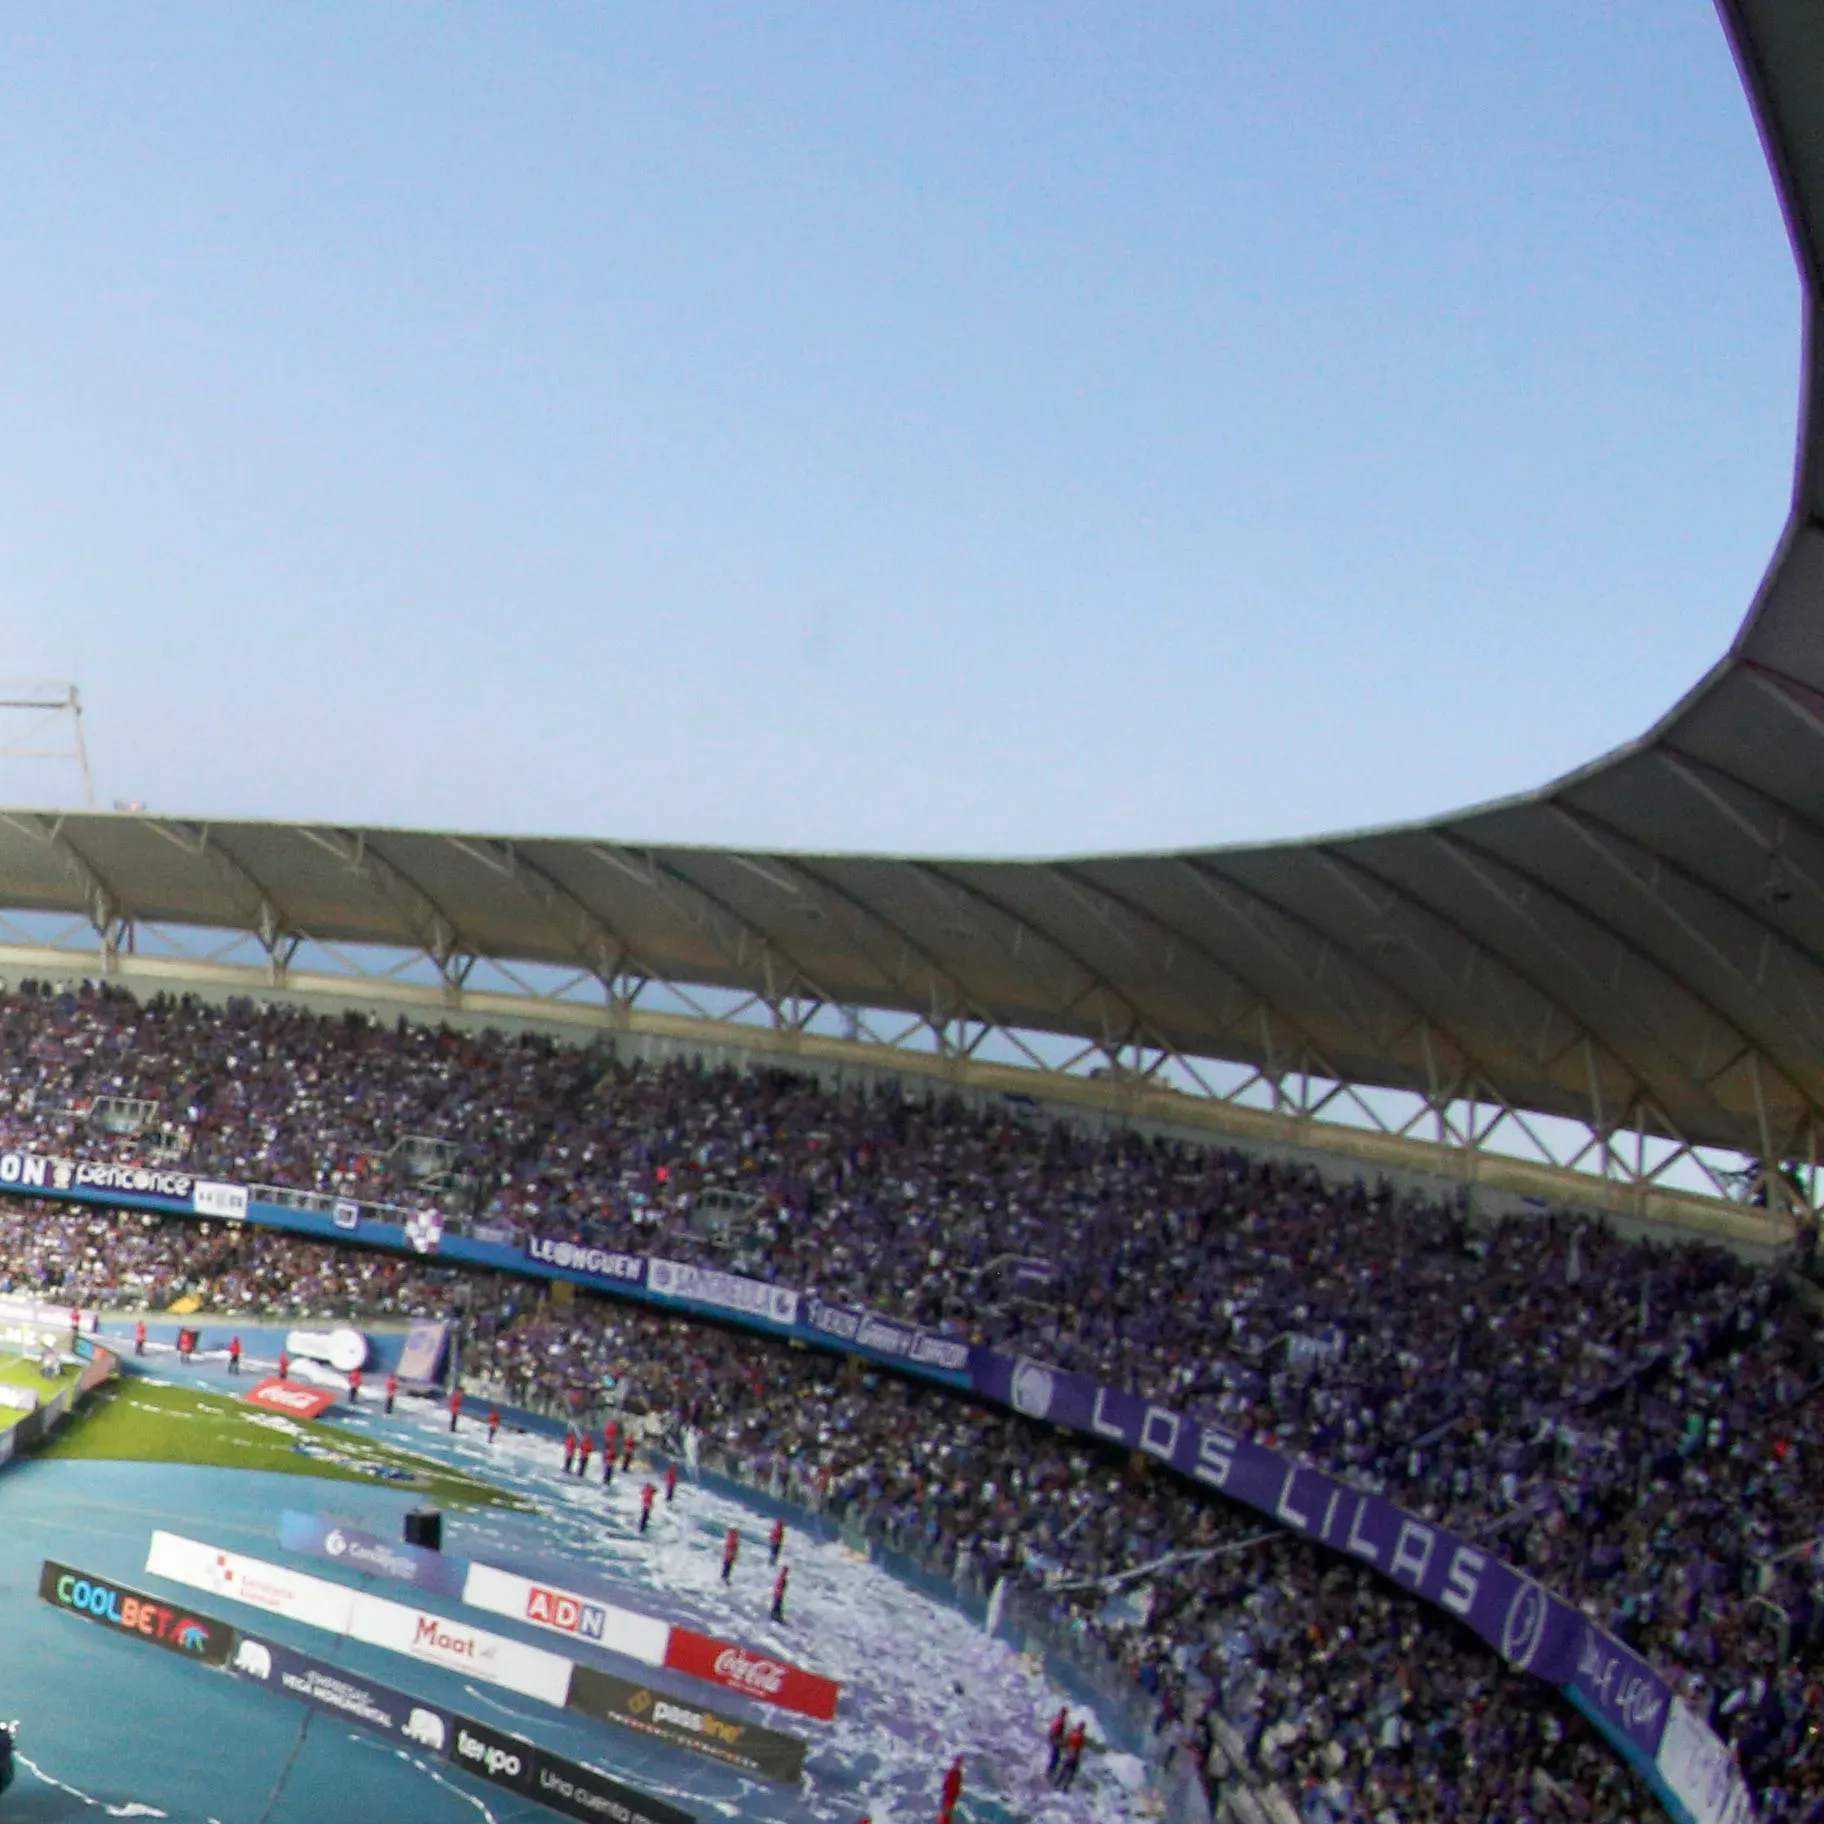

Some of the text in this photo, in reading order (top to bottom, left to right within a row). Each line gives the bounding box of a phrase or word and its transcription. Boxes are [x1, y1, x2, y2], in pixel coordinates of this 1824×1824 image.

[1091, 1387, 1487, 1614] LOS LILAS
[56, 1574, 175, 1639] COOLBET
[528, 1587, 603, 1639] ADN
[414, 1615, 475, 1656] Maat
[540, 1767, 573, 1797] Una
[574, 1788, 630, 1824] cuenta
